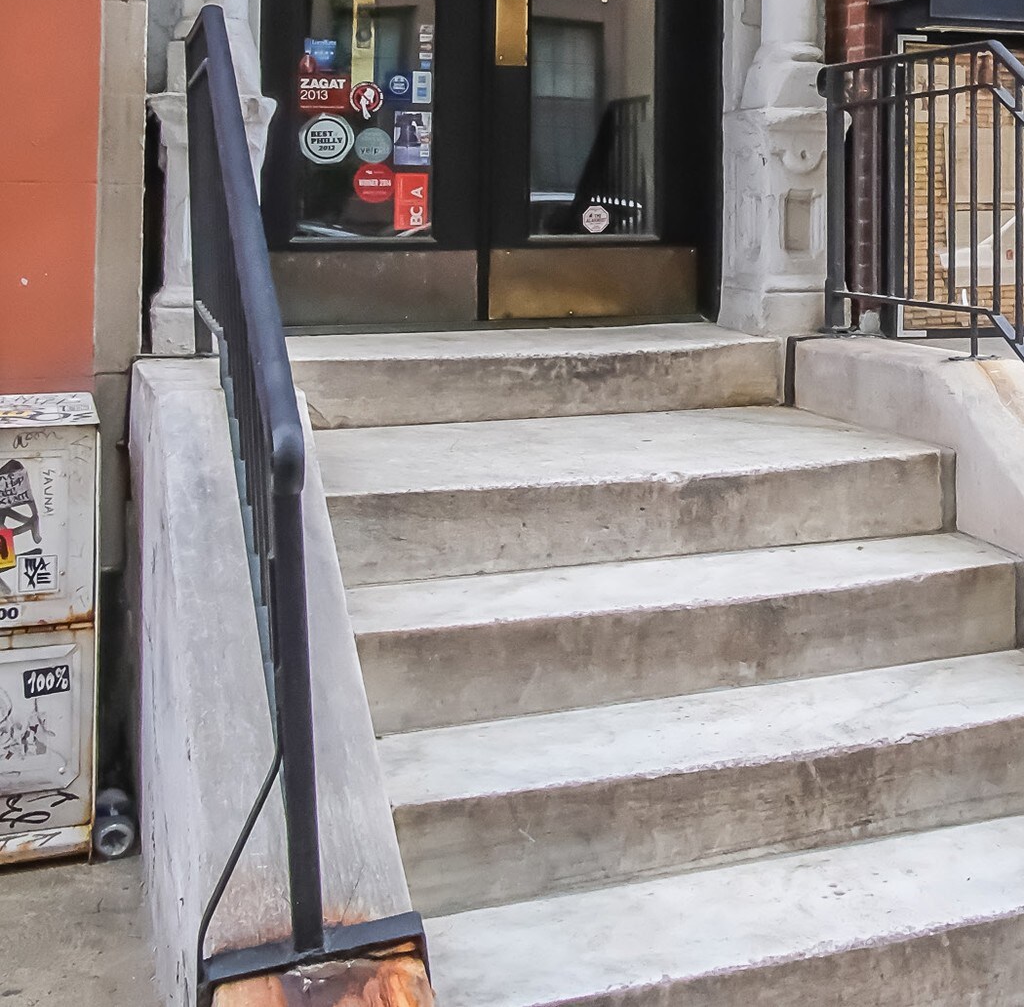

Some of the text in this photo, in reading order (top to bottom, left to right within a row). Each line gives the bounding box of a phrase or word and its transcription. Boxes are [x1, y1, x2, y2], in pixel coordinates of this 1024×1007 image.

[300, 78, 346, 90] ZAGAT
[300, 90, 328, 100] 2013
[27, 665, 68, 693] 100%
